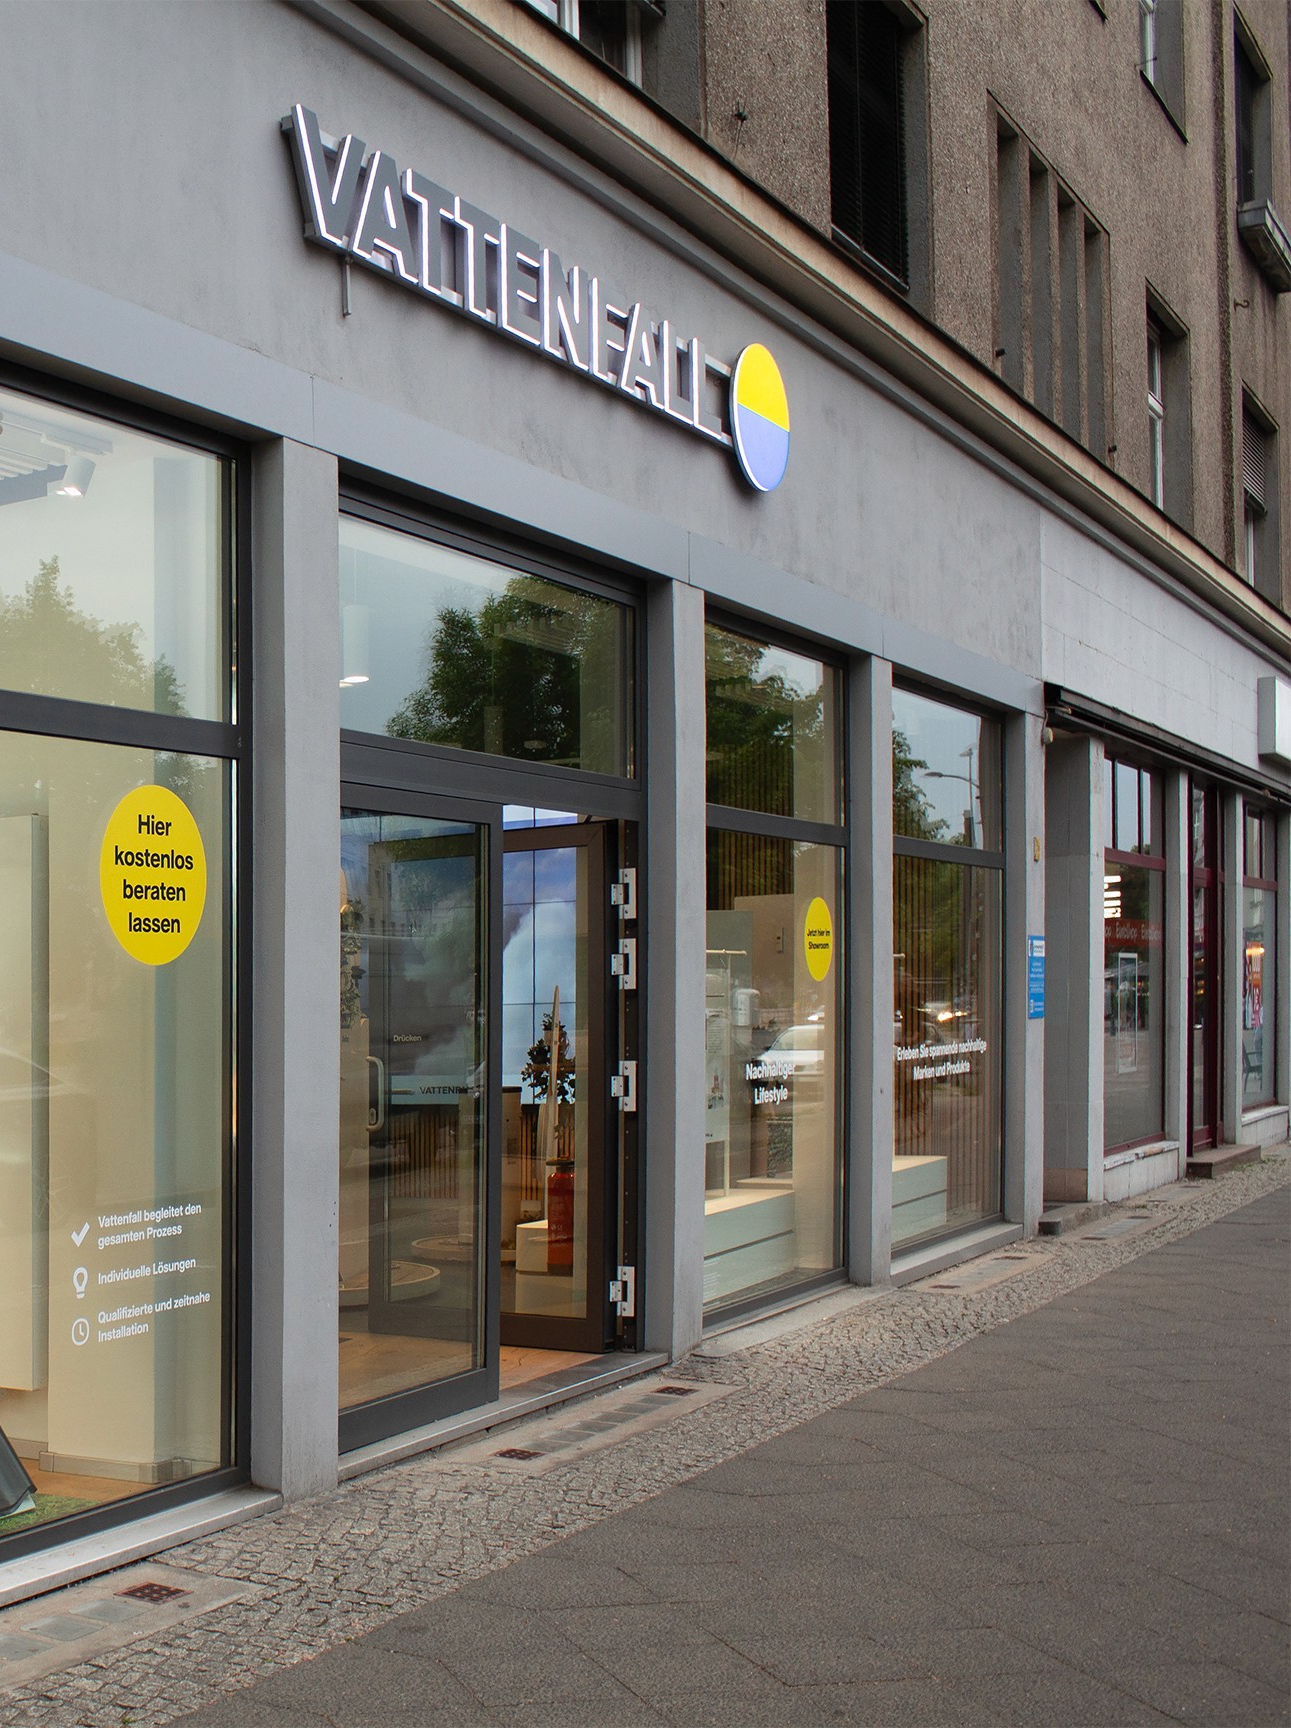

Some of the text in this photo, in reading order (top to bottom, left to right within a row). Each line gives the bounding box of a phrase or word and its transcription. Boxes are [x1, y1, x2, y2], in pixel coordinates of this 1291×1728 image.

[289, 103, 722, 441] VATTENFALL
[137, 814, 172, 836] Hier
[114, 845, 194, 870] kostenlos
[122, 879, 186, 901] beraten
[128, 912, 181, 933] lassen
[897, 1046, 919, 1061] Erleben
[919, 1044, 928, 1058] Sie
[746, 1060, 795, 1080] Nachhaltiger
[913, 1060, 970, 1080] Marken und Produkte
[420, 1086, 468, 1095] VATTENF
[754, 1084, 788, 1105] Lifestyle
[98, 1203, 202, 1228] Vattenfall begleitet den
[98, 1224, 183, 1250] gesamten Prozess
[98, 1257, 197, 1284] Individuelle Lösungen
[98, 1291, 211, 1324] Qualifizierte und zeitnahe
[98, 1322, 149, 1342] Installation
